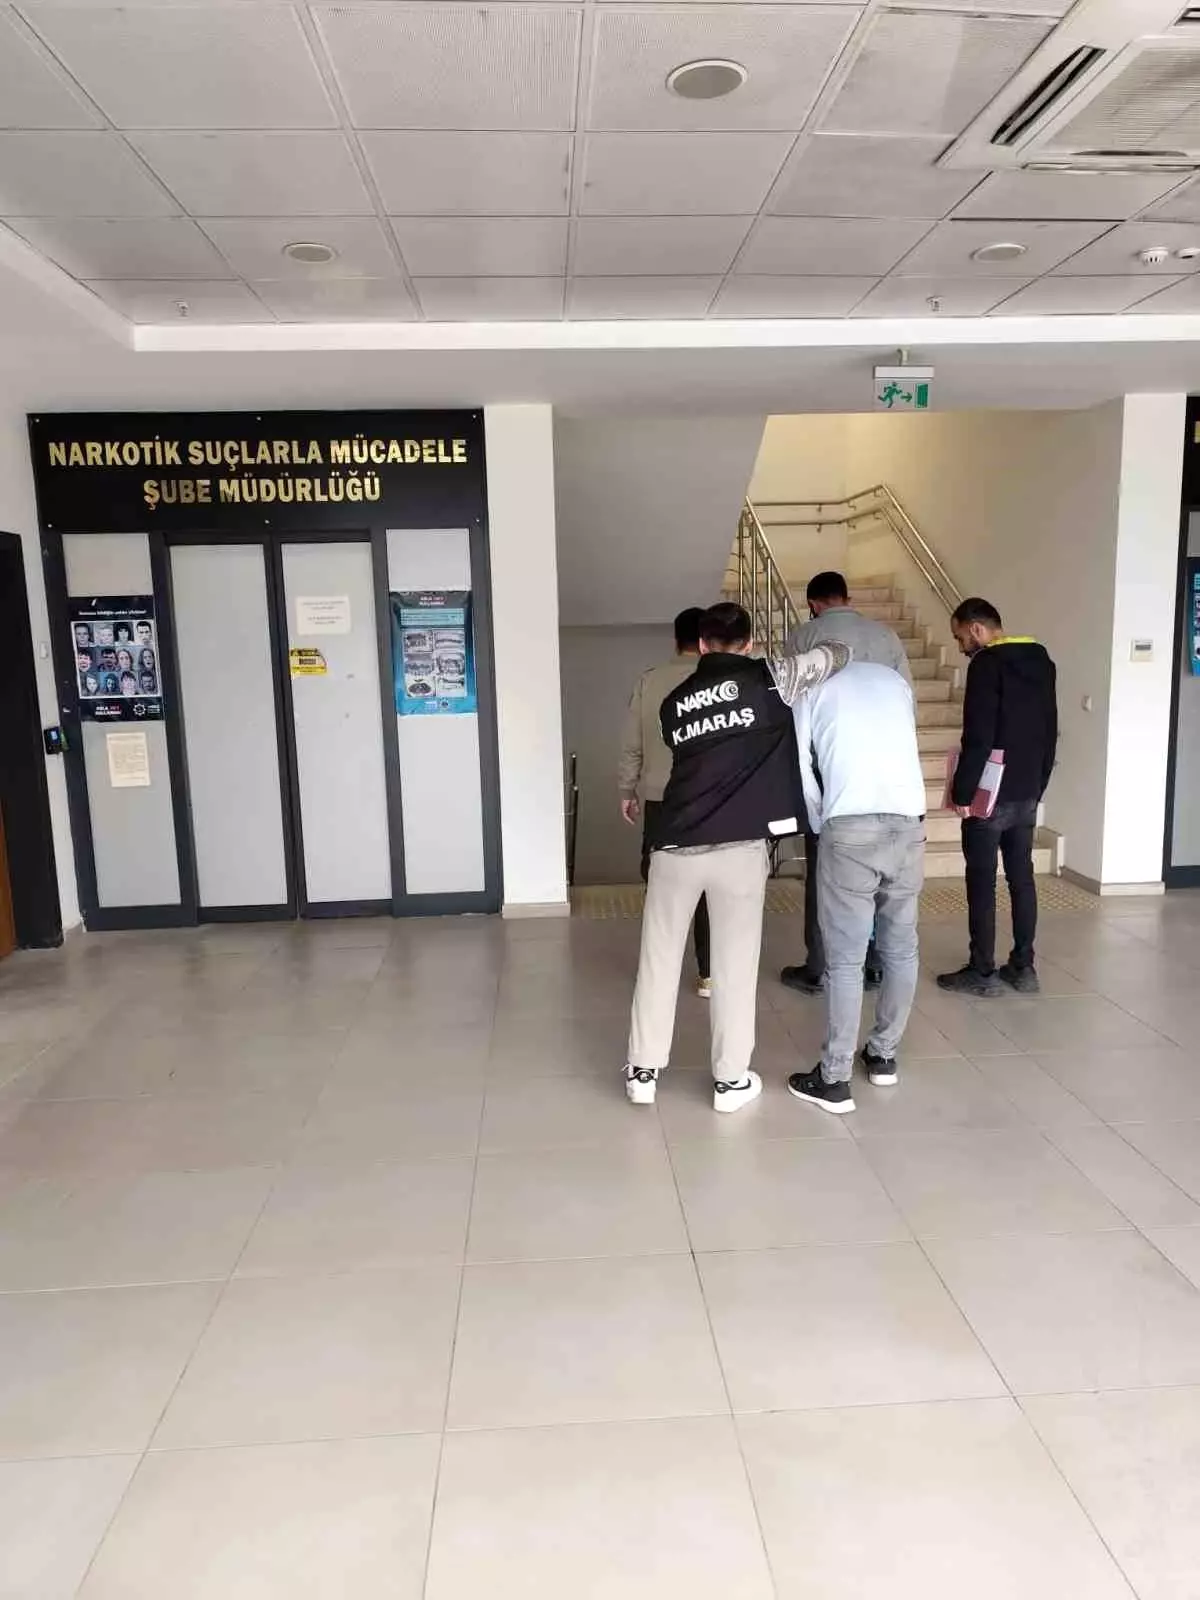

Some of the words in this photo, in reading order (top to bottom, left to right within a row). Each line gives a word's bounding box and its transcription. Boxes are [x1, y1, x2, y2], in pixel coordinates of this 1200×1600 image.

[48, 435, 182, 467] NARKOTİK
[187, 438, 323, 470] SUÇLARLA
[330, 433, 468, 464] MÜCADELE
[143, 478, 212, 510] ŞUBE
[219, 470, 380, 504] MÜDÜRLÜĞÜ
[672, 708, 755, 745] K.MARAŞ
